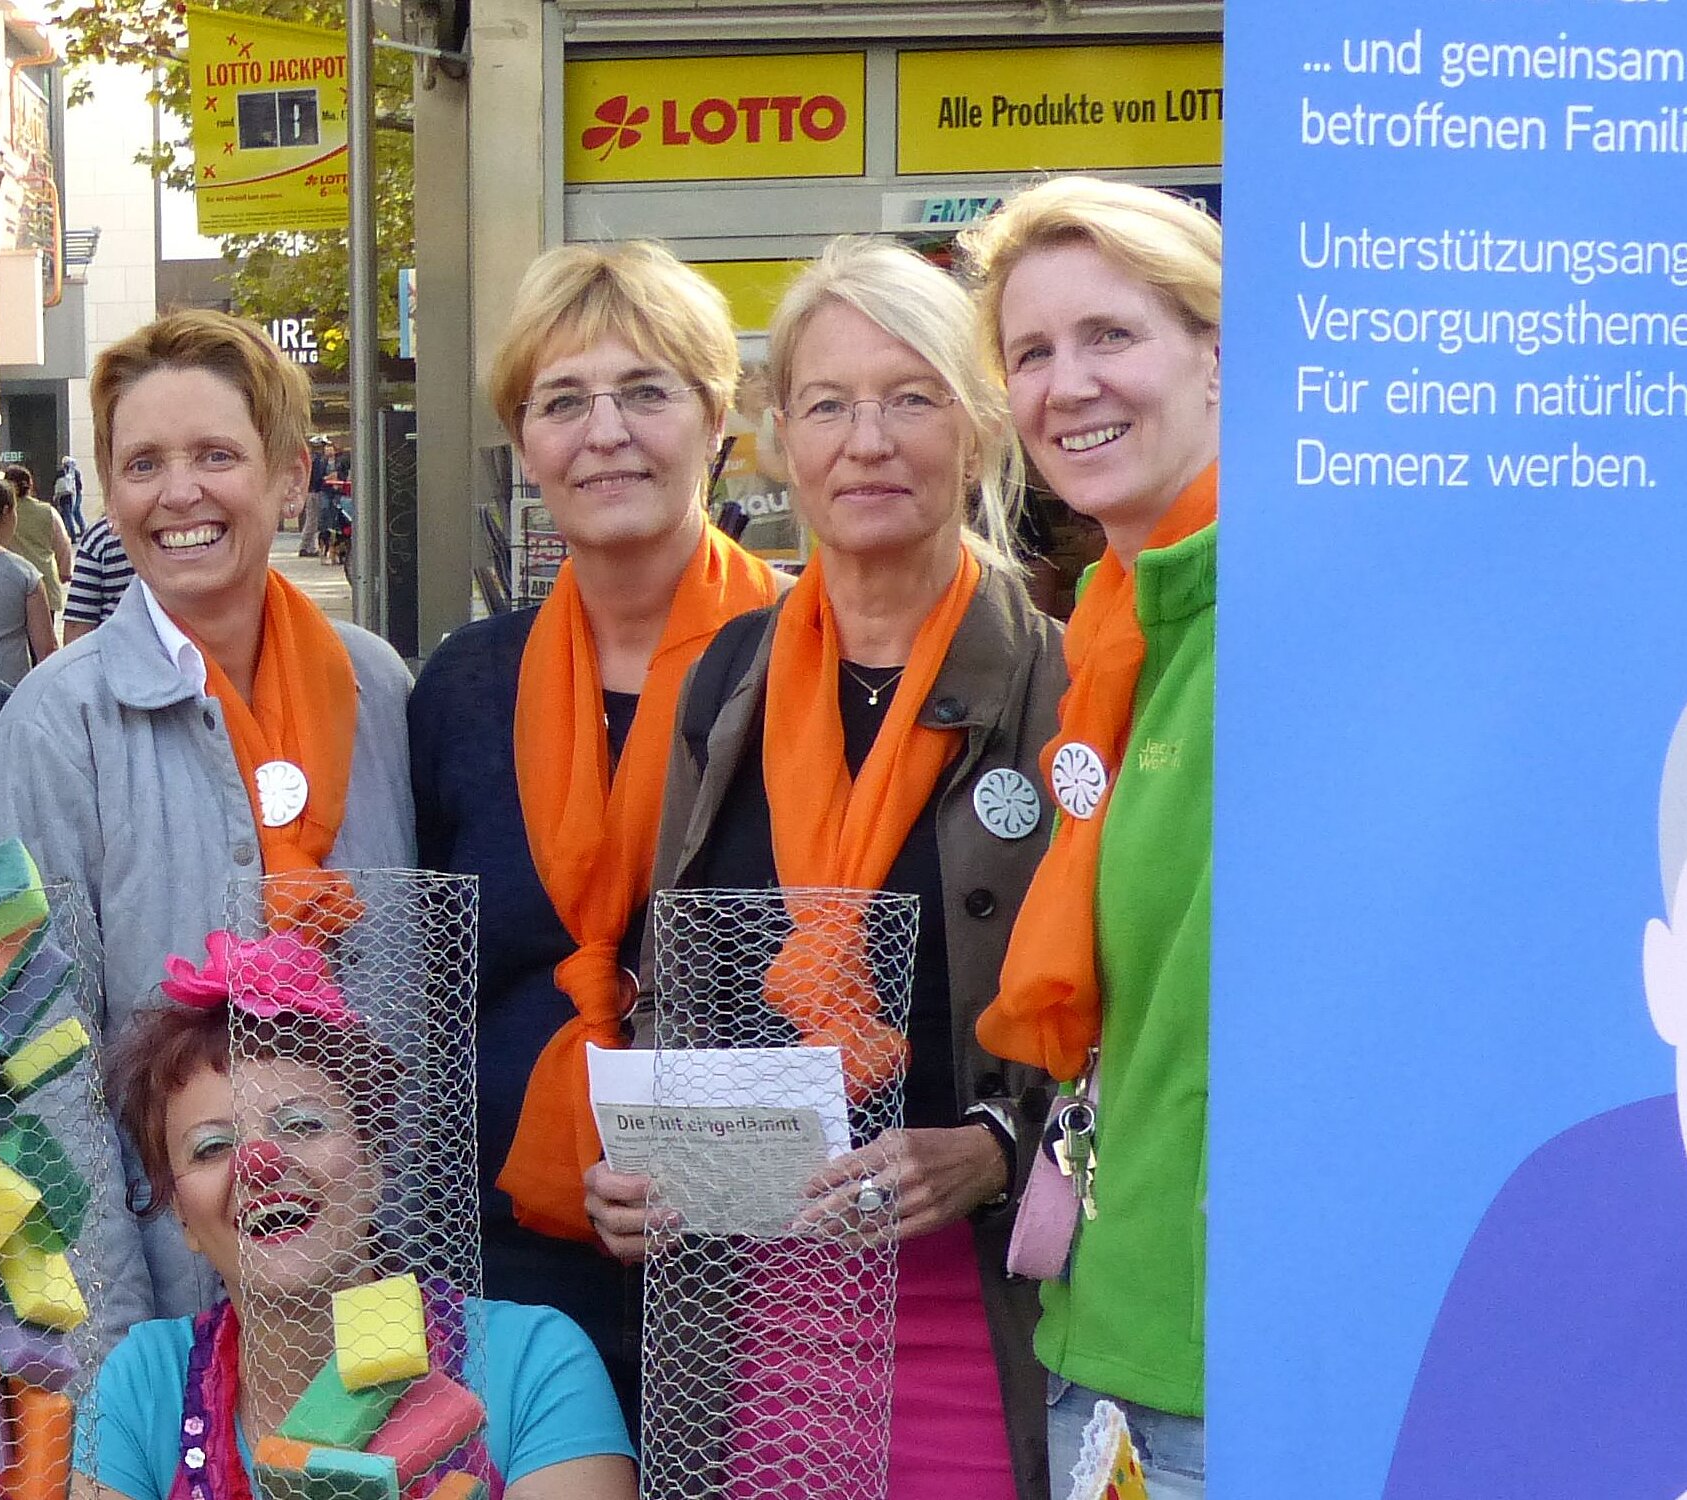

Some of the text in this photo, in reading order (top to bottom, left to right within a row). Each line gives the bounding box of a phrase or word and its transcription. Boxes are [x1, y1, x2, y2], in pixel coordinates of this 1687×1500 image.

[206, 55, 346, 87] LOTTO JACKPOT
[1440, 32, 1684, 88] gemeinsam
[662, 95, 846, 145] LOTTO
[938, 96, 982, 129] Alle
[992, 93, 1103, 127] Produkte
[1114, 98, 1156, 123] von
[1302, 97, 1546, 150] betroffenen
[284, 350, 319, 364] ING
[1298, 366, 1368, 413] Für
[1386, 368, 1496, 414] einen
[1297, 439, 1655, 487] Demenz werben.
[617, 1114, 646, 1131] Die
